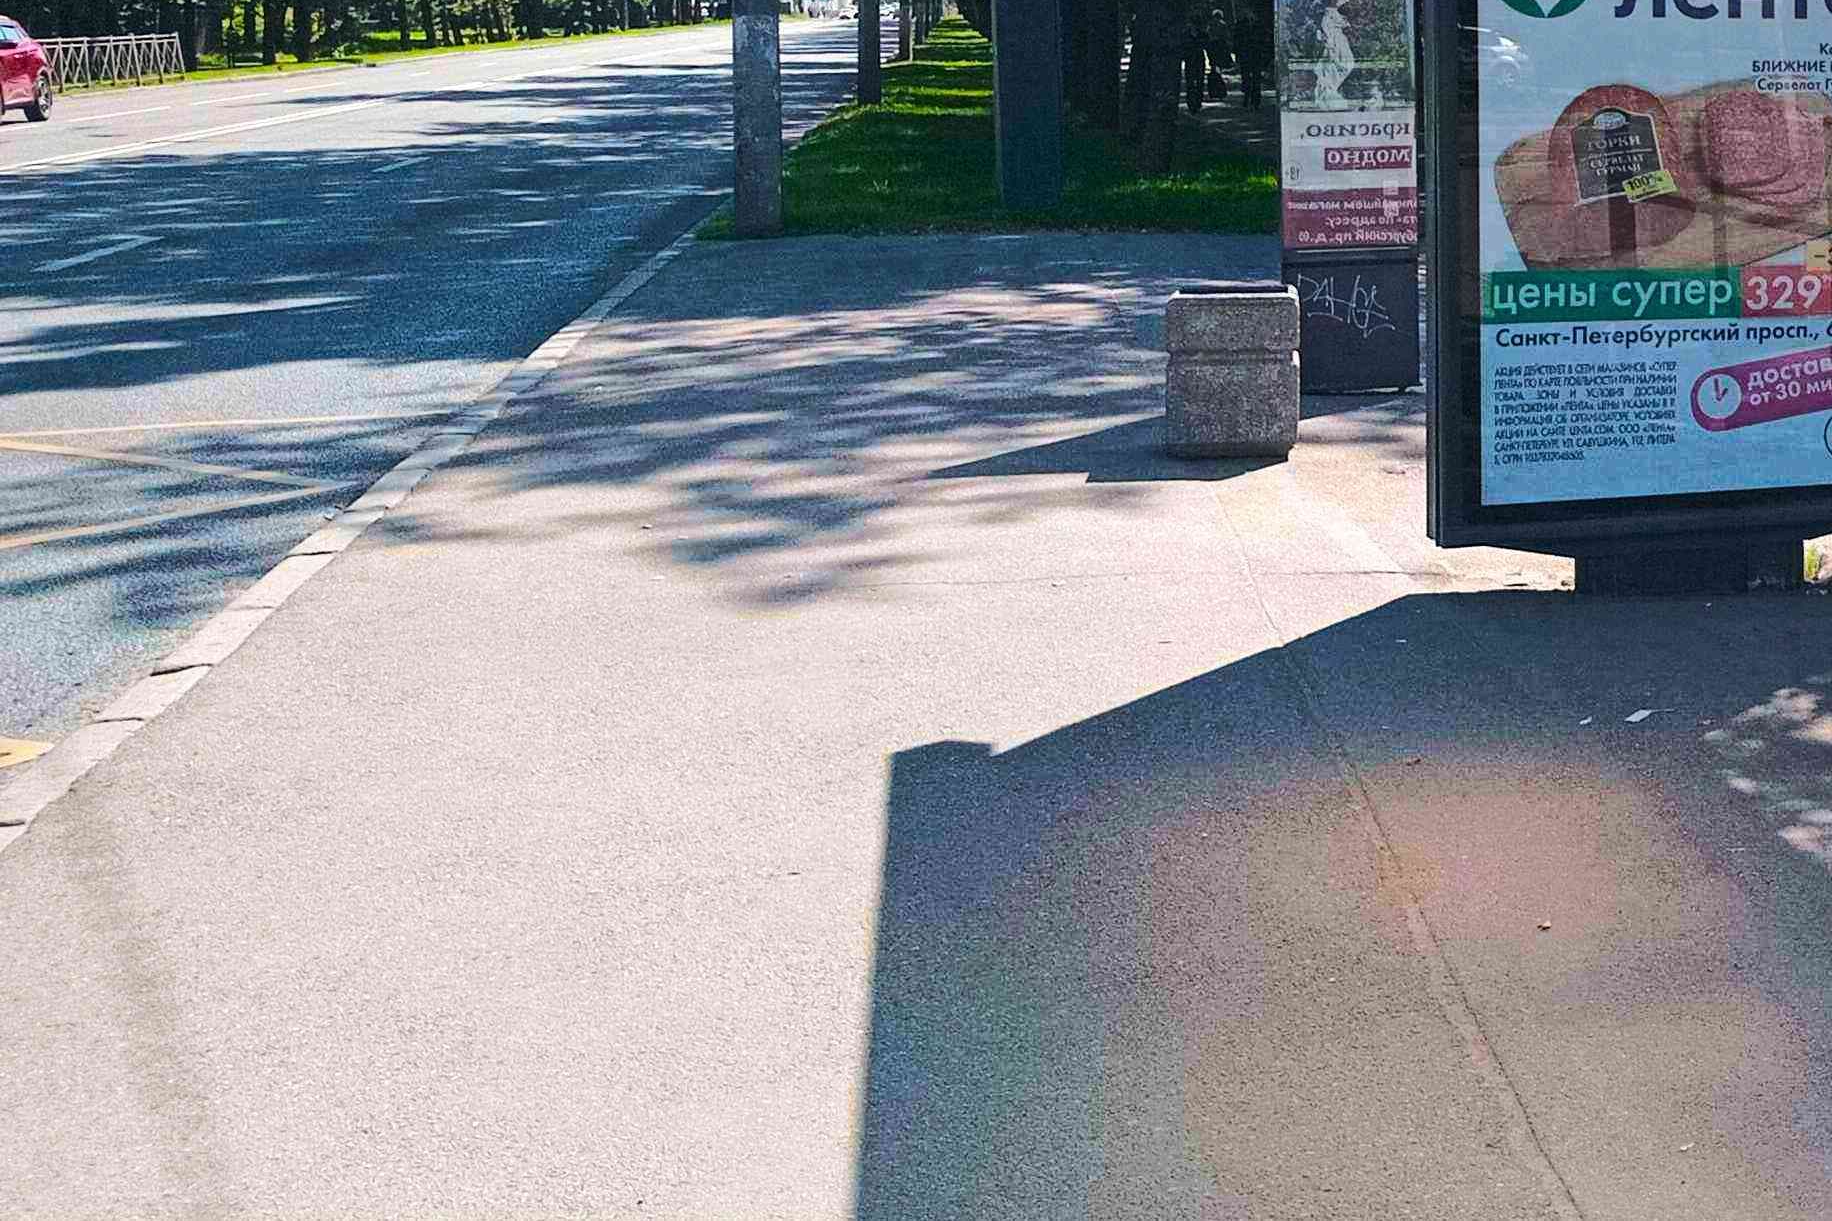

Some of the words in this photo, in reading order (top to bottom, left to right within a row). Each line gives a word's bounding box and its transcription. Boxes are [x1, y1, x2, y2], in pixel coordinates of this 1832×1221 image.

[1752, 60, 1826, 73] БЛИЖНИЕ
[1492, 282, 1596, 315] цены
[1612, 277, 1733, 317] супер
[1746, 274, 1822, 311] 329
[1495, 323, 1739, 349] Санкт-Петербургский
[1746, 324, 1820, 345] просп.,
[1750, 390, 1771, 405] от
[1776, 382, 1801, 401] 30
